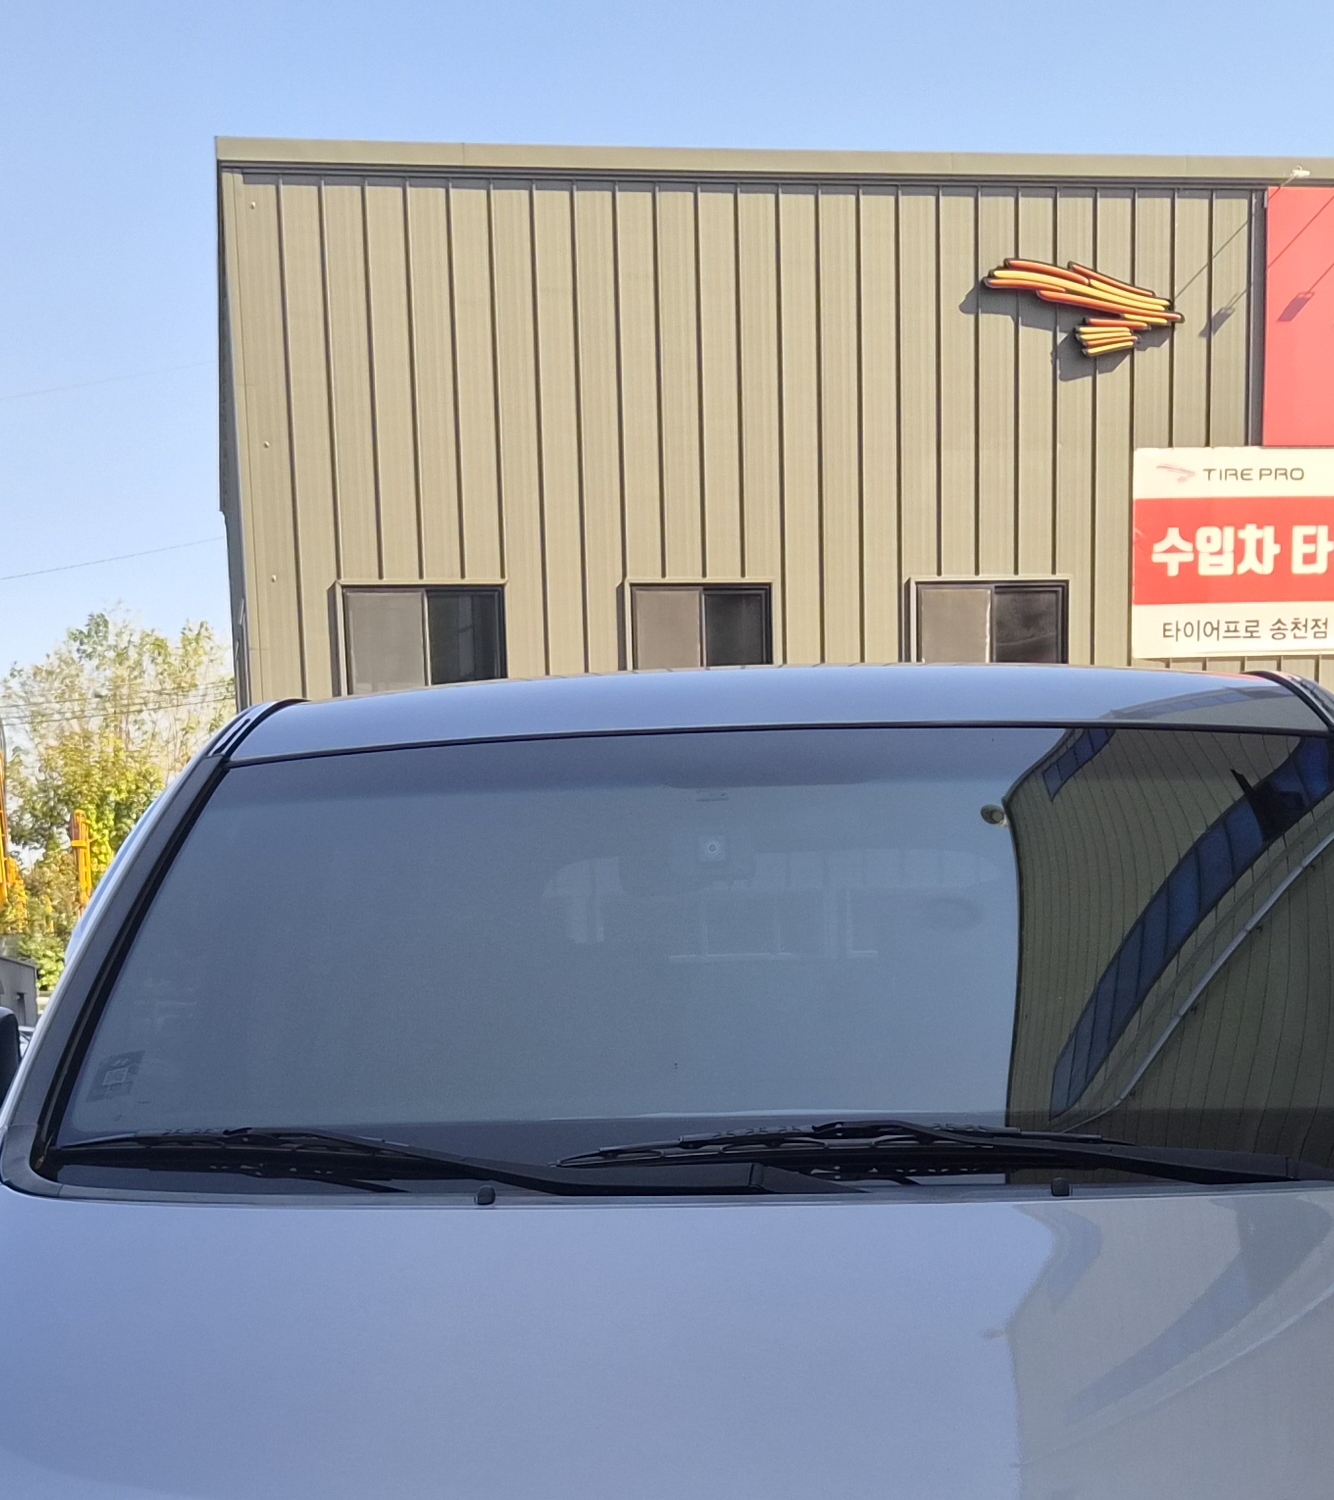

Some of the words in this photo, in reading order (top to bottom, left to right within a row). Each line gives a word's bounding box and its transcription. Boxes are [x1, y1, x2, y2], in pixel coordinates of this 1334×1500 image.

[1202, 467, 1253, 481] TIRE
[1259, 467, 1305, 481] PRO
[1151, 523, 1281, 577] 수입차
[1162, 619, 1262, 642] 타이어프로
[1269, 617, 1329, 641] 송천점
